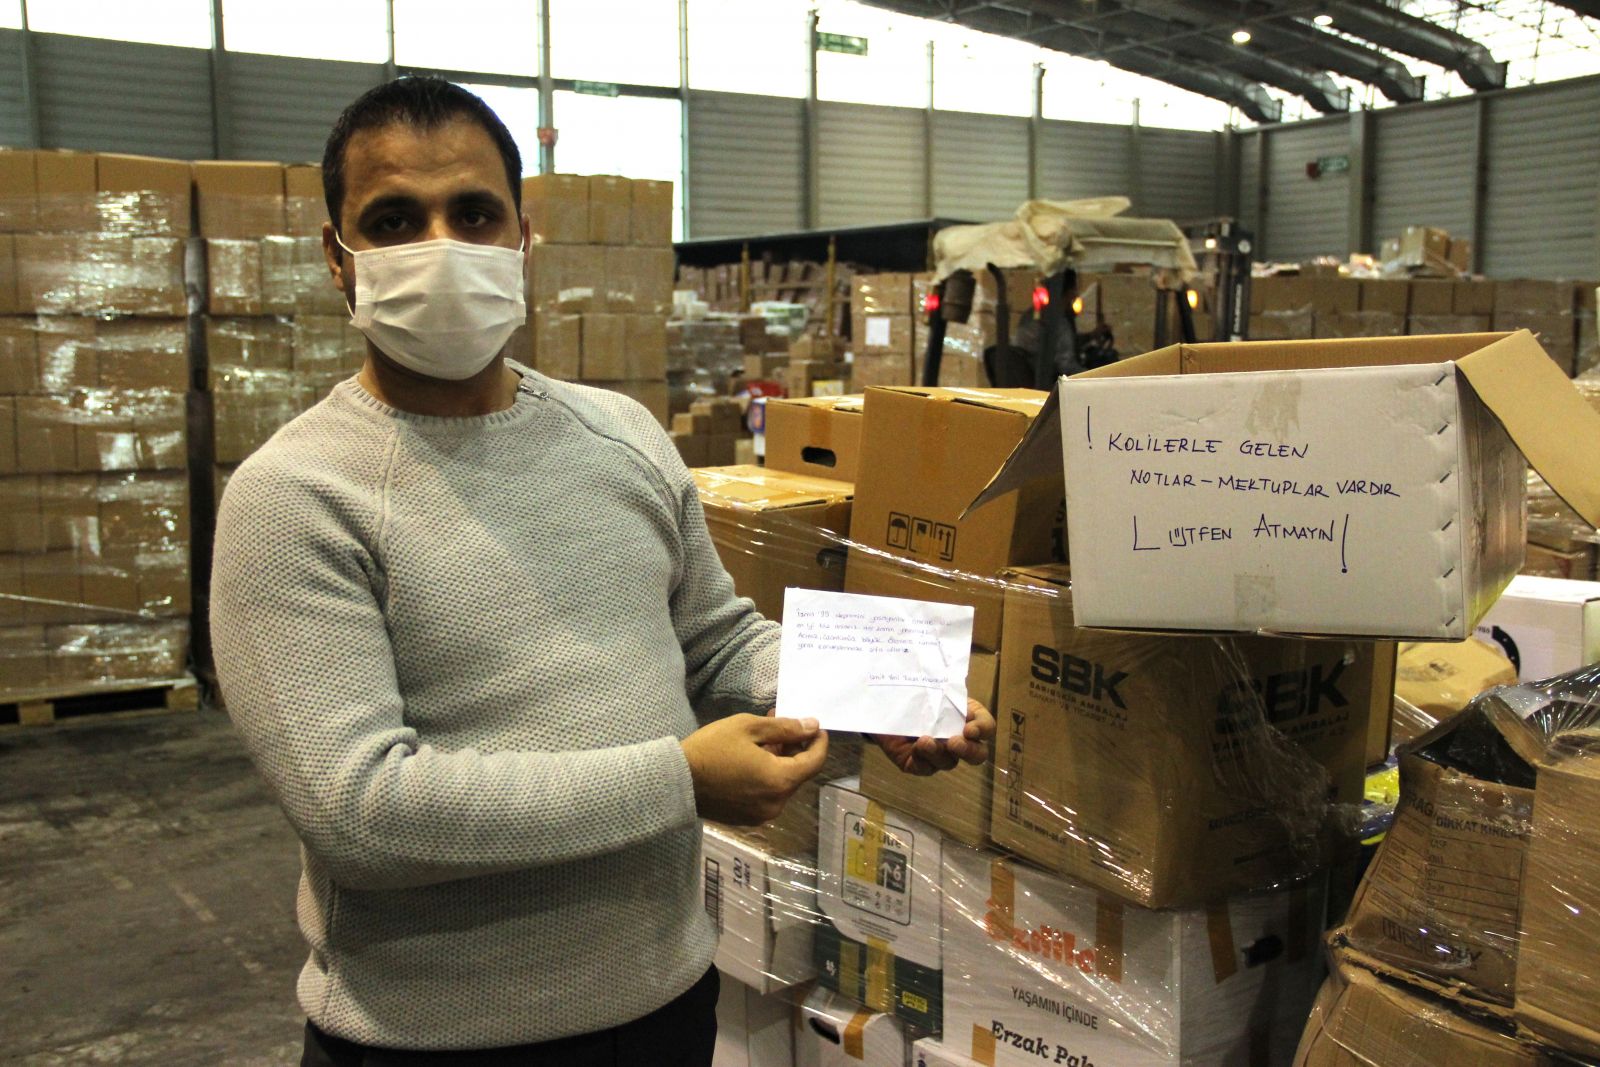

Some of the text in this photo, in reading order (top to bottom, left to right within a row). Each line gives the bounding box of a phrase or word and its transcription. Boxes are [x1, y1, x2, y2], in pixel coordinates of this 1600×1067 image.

[1239, 440, 1310, 459] GELEN
[1130, 468, 1196, 487] NOTLAR
[1218, 476, 1330, 498] MEKTUPLAR
[1336, 479, 1402, 498] VARDIR
[1031, 644, 1130, 710] SBK
[1215, 655, 1351, 735] SBK
[733, 856, 743, 889] 100
[892, 863, 902, 882] 6
[1011, 985, 1099, 1030] YAŞAMIN İÇİNDE
[991, 1019, 1049, 1059] Erzak
